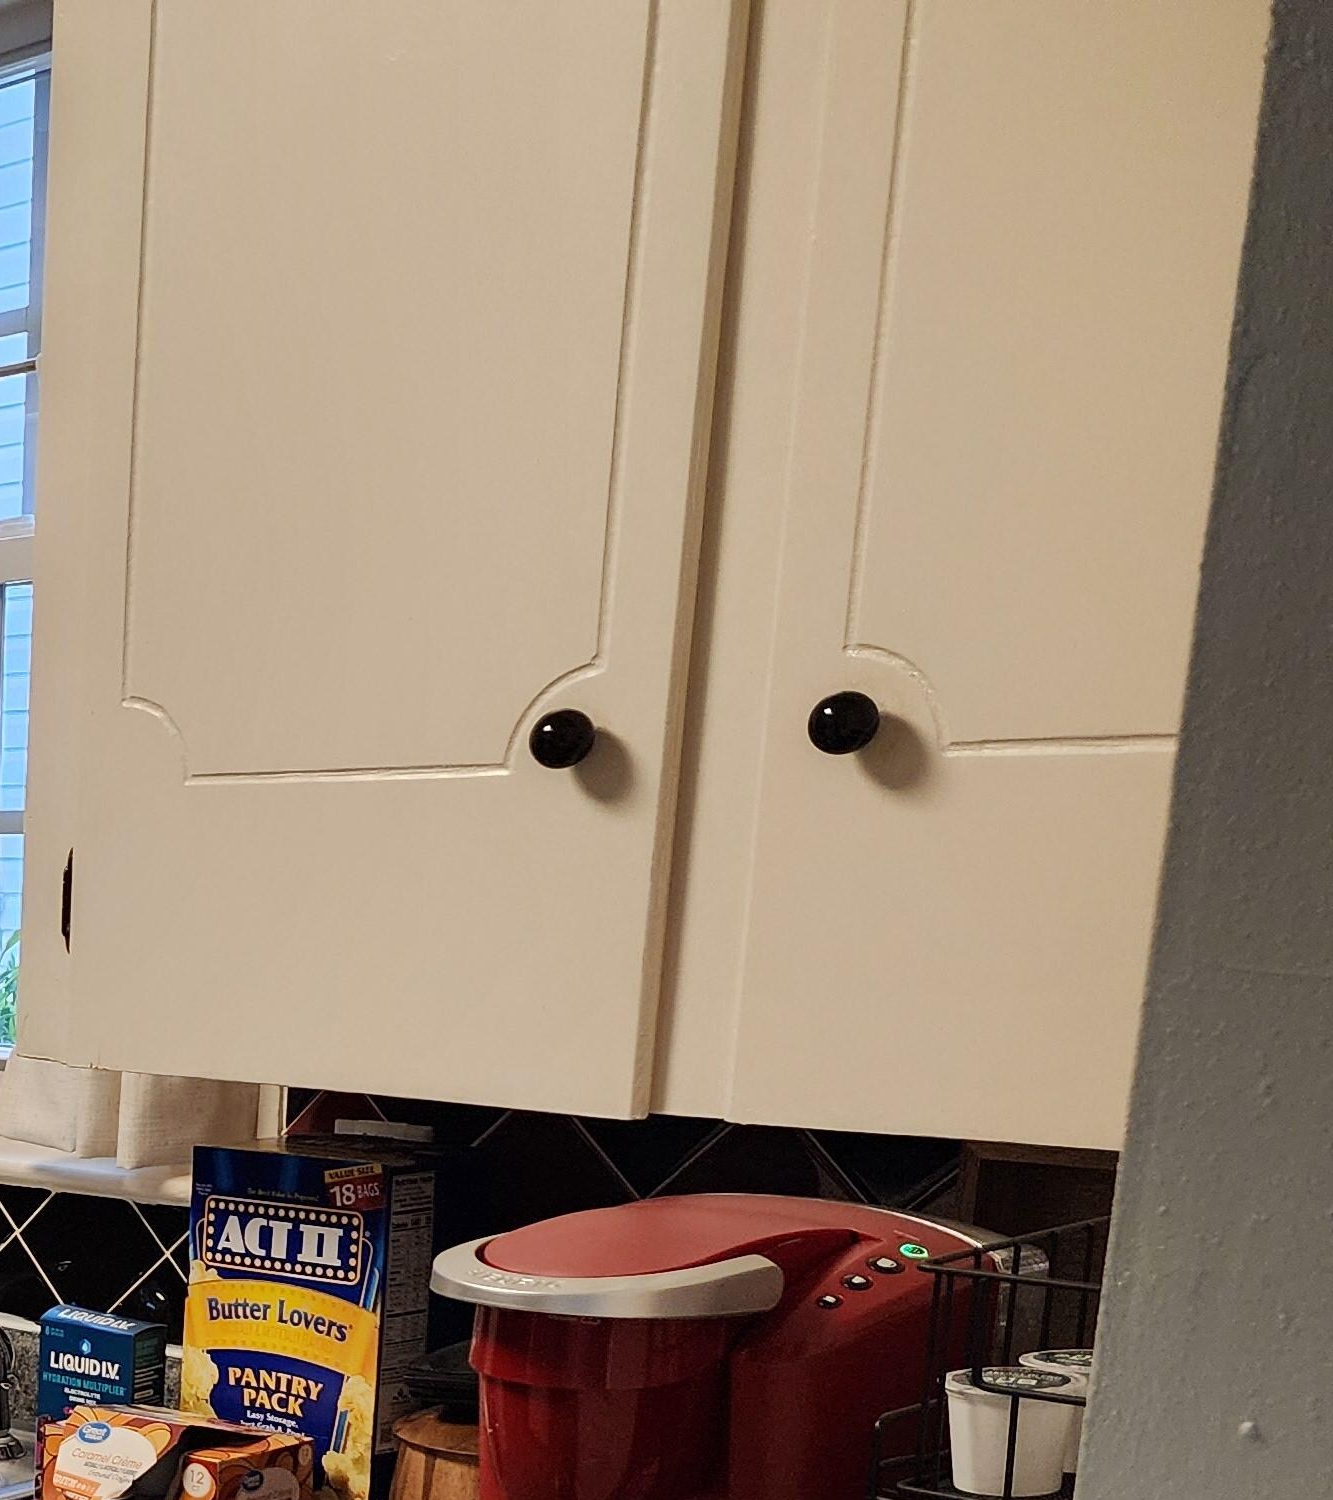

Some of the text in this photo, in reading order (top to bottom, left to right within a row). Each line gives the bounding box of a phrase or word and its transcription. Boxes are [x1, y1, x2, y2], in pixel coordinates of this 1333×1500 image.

[328, 1165, 375, 1180] VALUE SIZE
[329, 1182, 380, 1207] 18 BAGS
[217, 1215, 344, 1267] ACT II
[58, 1308, 114, 1328] LIQUID
[206, 1298, 348, 1343] Butter Lovers
[49, 1351, 100, 1377] LIQUID
[42, 1371, 82, 1388] HYDRATION
[228, 1367, 324, 1401] PANTRY
[243, 1388, 304, 1418] PACK
[247, 1410, 264, 1421] Easy
[72, 1447, 112, 1463] Caramel
[190, 1469, 205, 1485] 12
